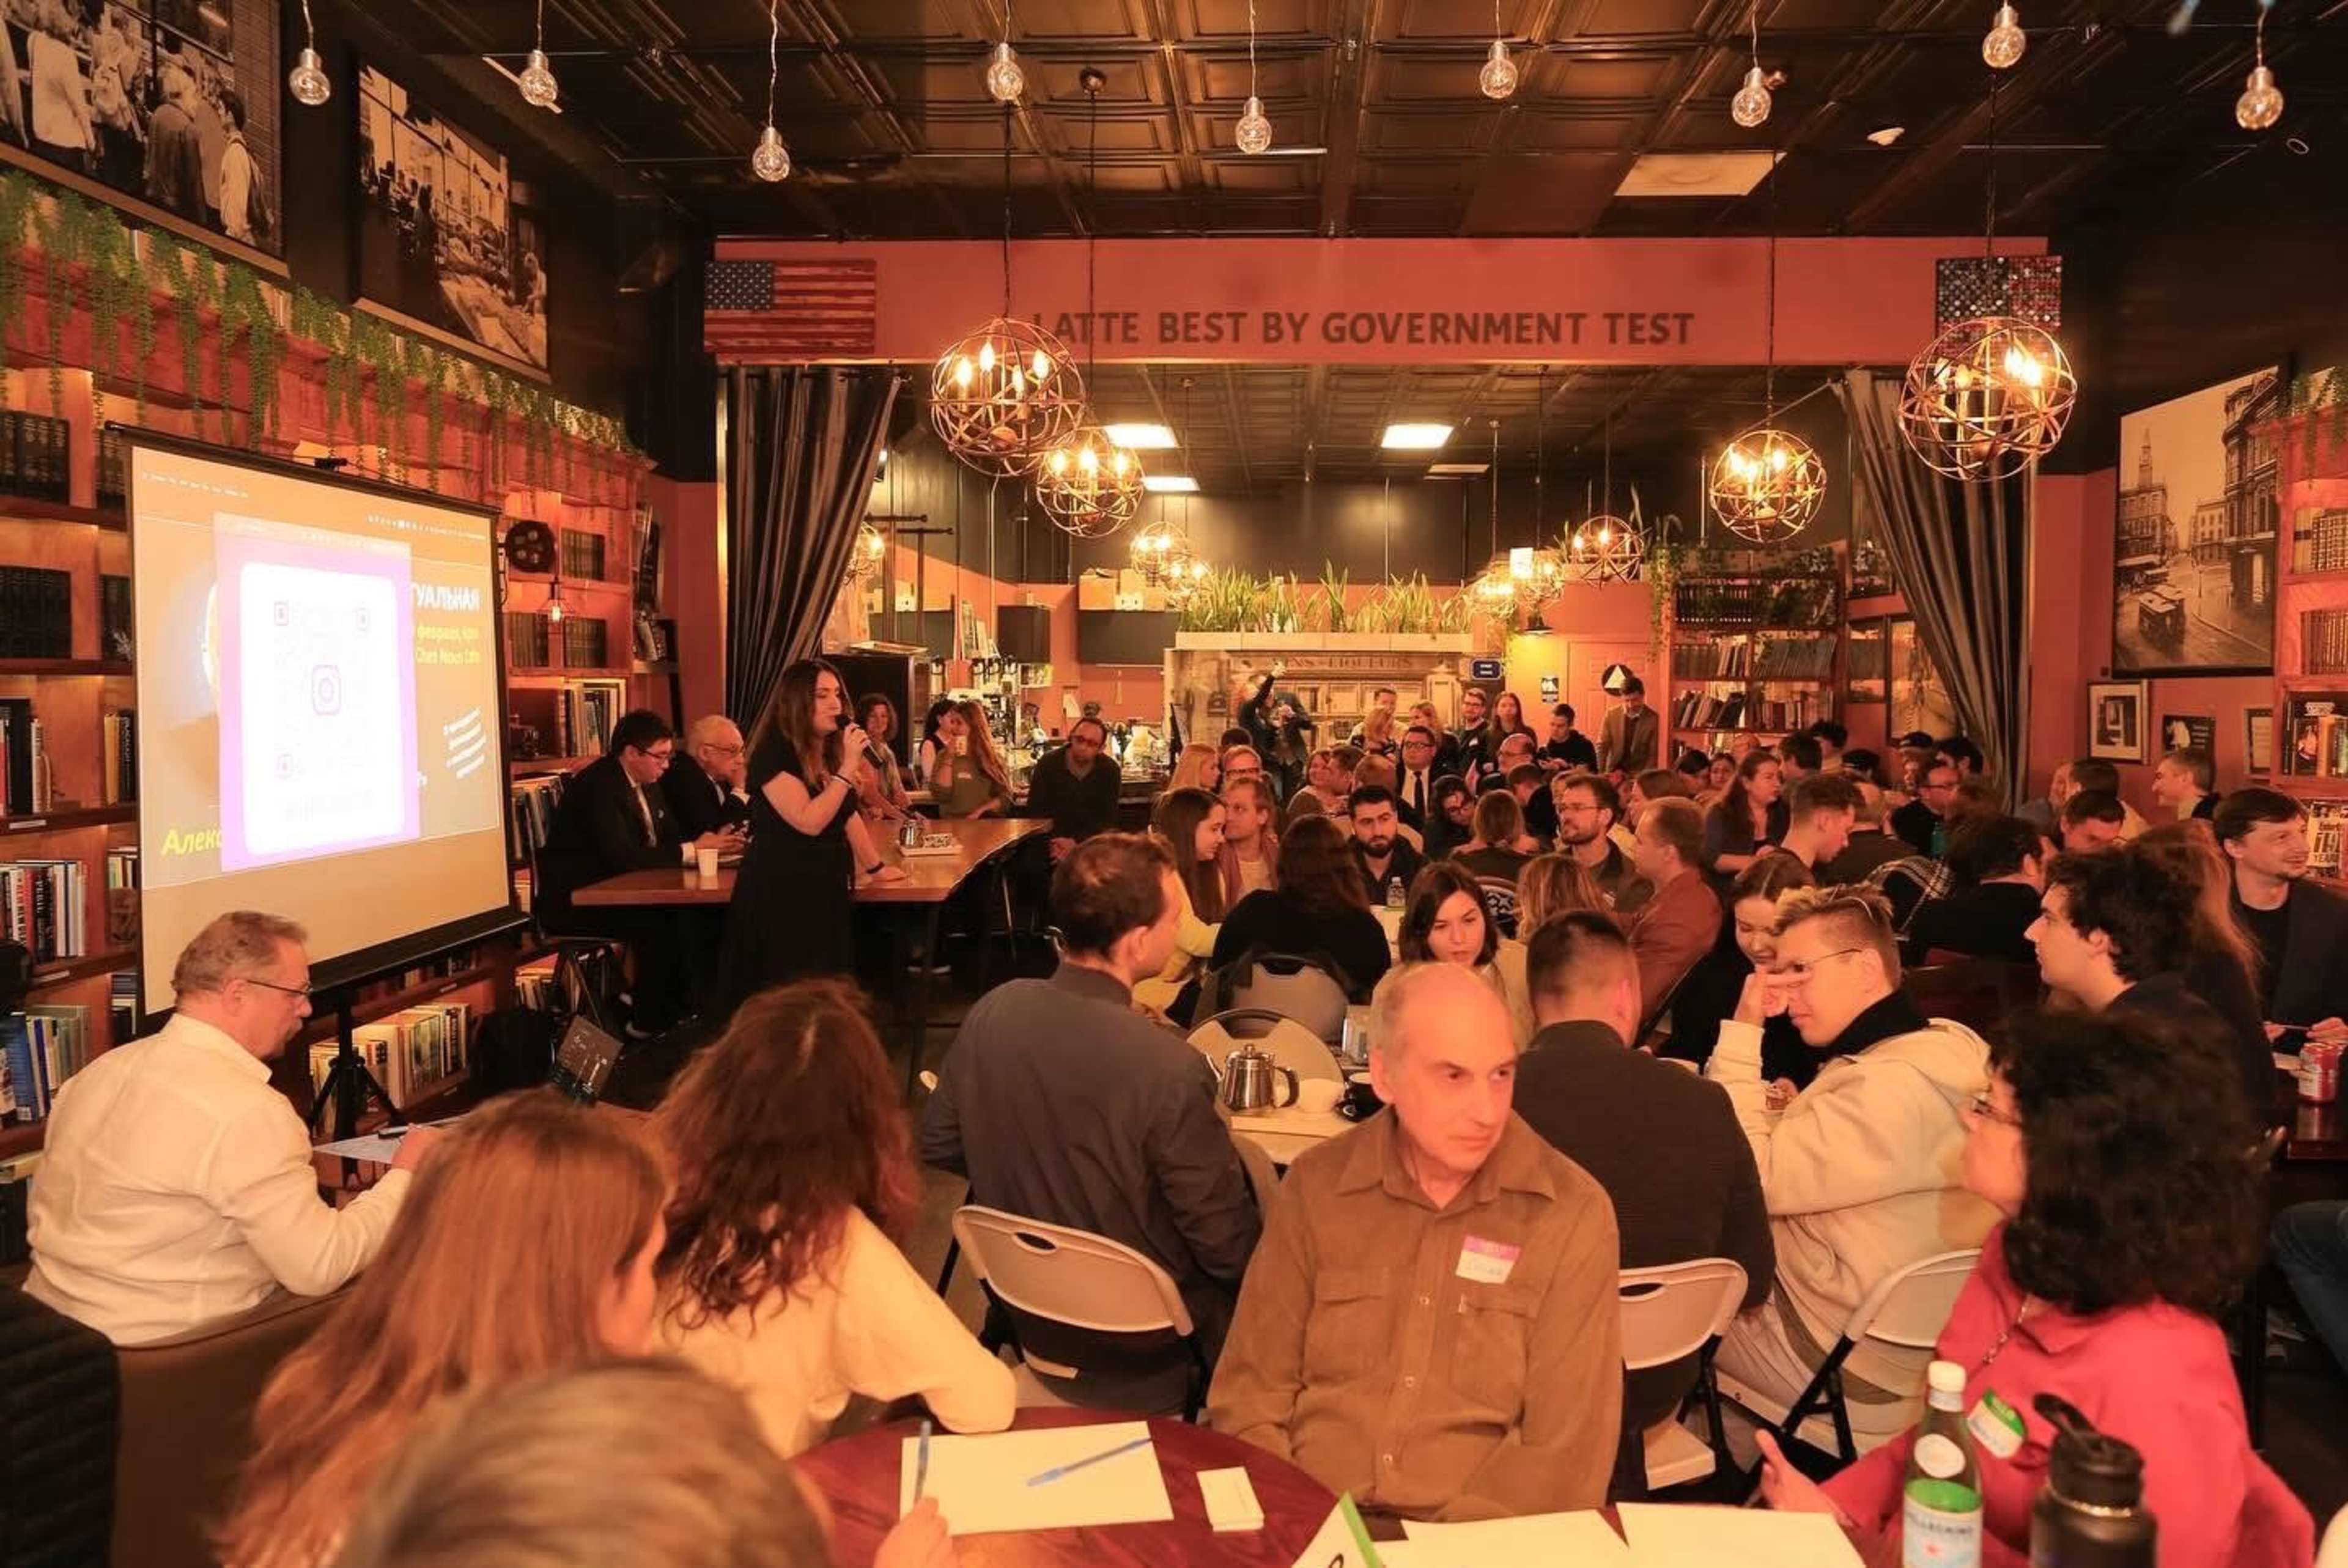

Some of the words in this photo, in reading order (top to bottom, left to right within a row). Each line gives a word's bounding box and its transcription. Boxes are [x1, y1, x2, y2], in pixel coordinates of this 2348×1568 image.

[1033, 312, 1139, 344] LATTE
[1158, 312, 1248, 344] BEST
[1262, 312, 1310, 344] BY
[1321, 312, 1588, 345] GOVERNMENT
[1603, 312, 1695, 345] TEST
